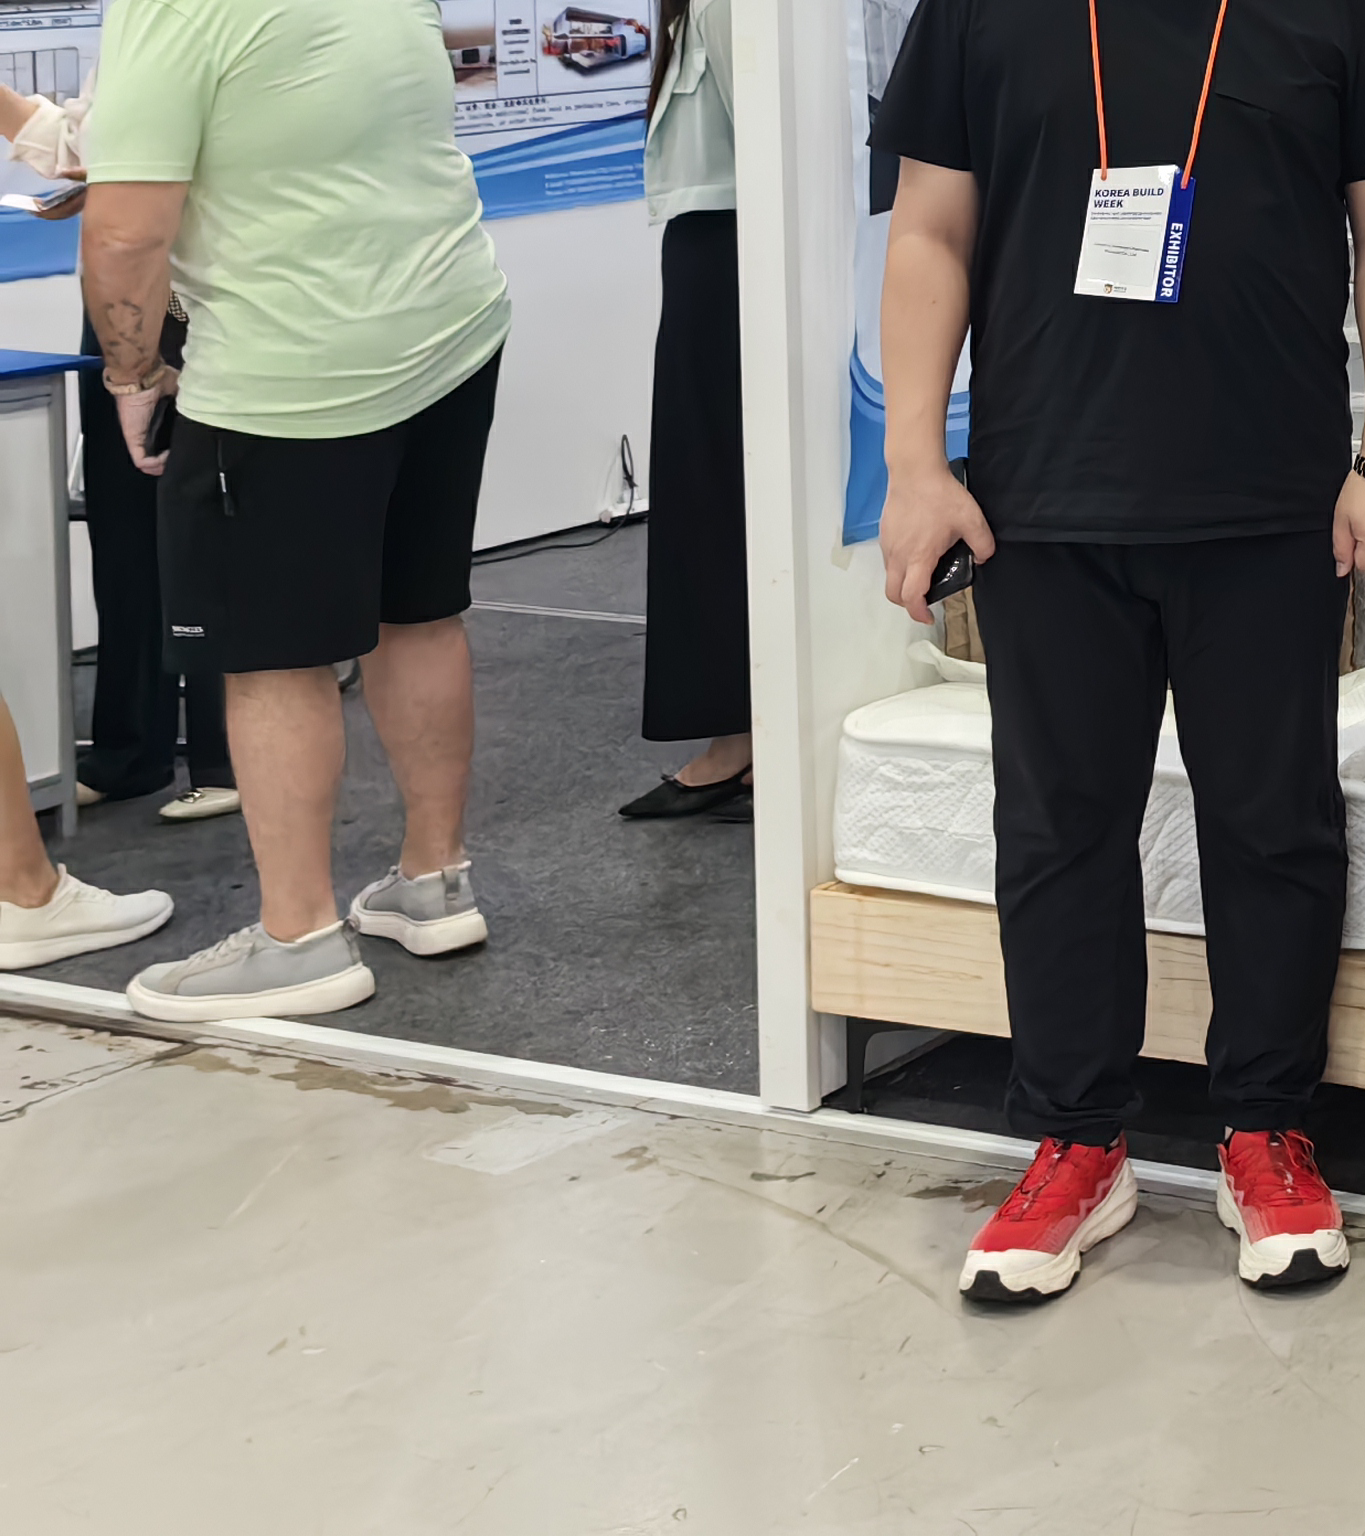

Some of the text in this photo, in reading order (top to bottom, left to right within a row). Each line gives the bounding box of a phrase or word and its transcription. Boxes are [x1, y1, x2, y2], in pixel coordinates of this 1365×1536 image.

[1095, 188, 1164, 198] KOREA BUILD
[1093, 199, 1124, 208] WEEK
[1160, 222, 1184, 298] EXHIBITOR
